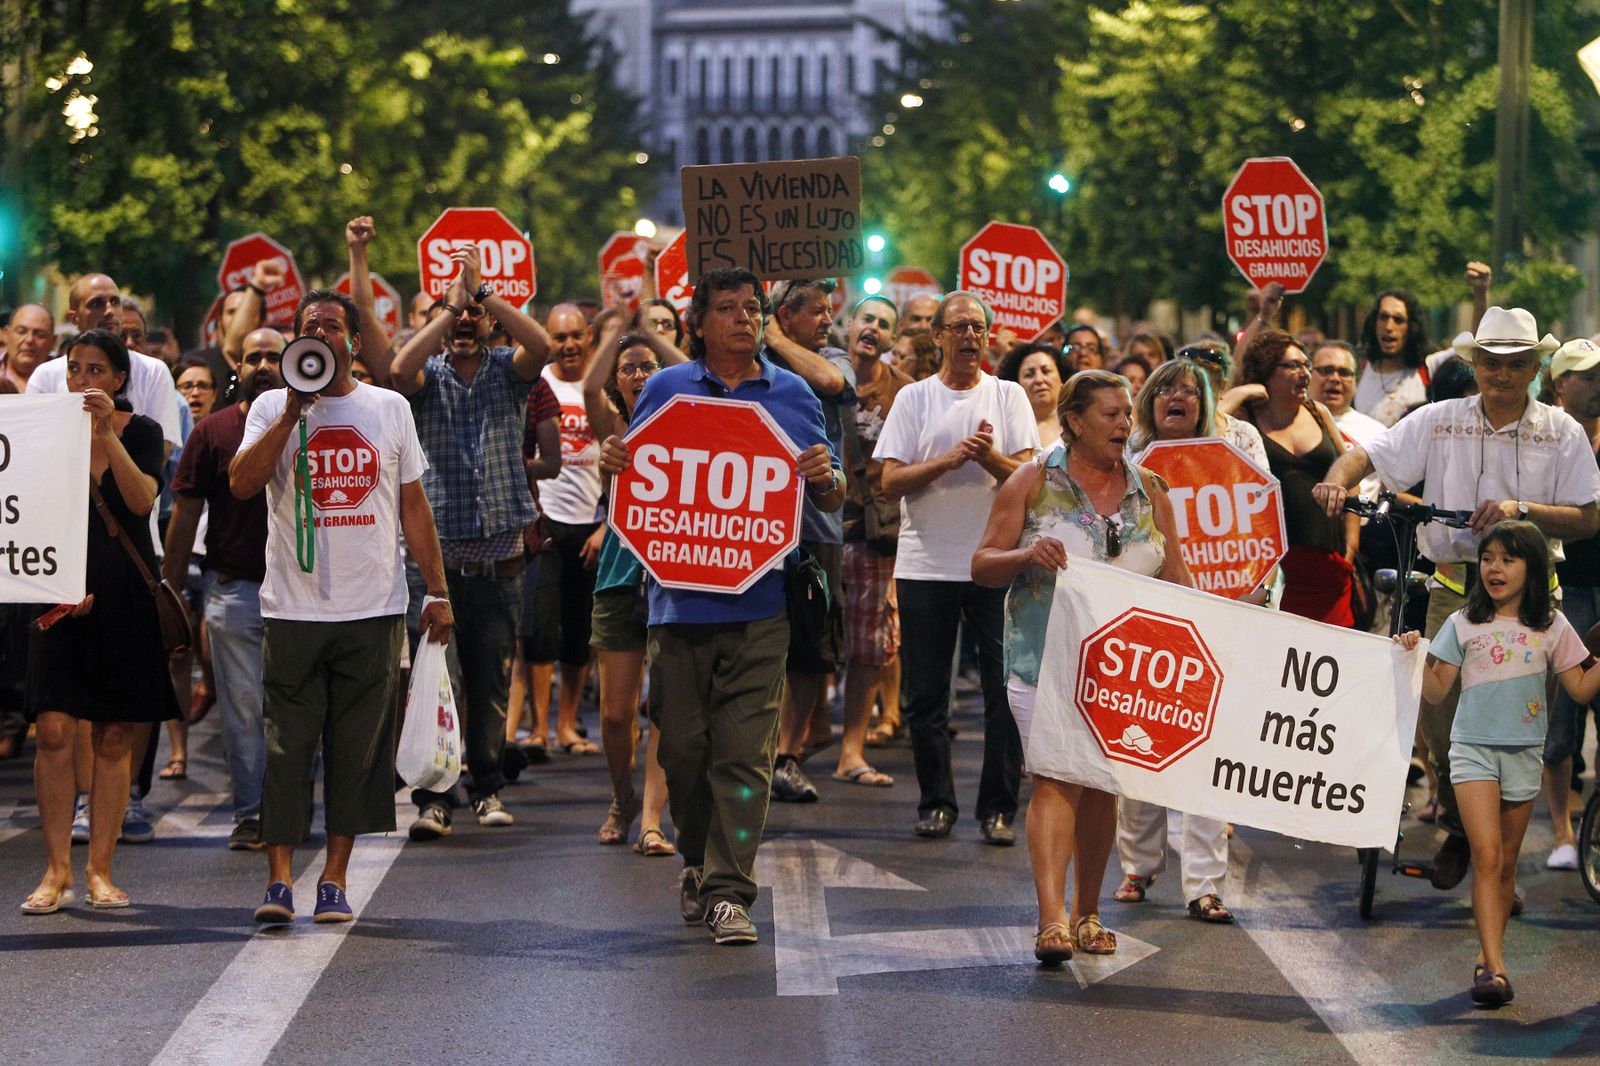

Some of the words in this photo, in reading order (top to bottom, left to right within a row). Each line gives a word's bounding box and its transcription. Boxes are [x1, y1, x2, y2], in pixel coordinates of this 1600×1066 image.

[698, 175, 728, 200] LA
[697, 204, 731, 237] NO
[740, 204, 767, 234] ES
[1231, 194, 1318, 237] STOP
[1234, 239, 1321, 257] DESAHUCIOS
[968, 248, 1060, 295] STOP
[1249, 262, 1308, 278] GRANADA
[307, 447, 373, 476] STOP
[630, 443, 791, 512] STOP
[311, 475, 372, 489] ESAHUCIOS
[324, 514, 376, 528] GRANADA
[626, 505, 786, 545] DESAHUCIOS
[1168, 482, 1269, 539] TOP
[647, 540, 753, 571] GRANADA
[1180, 536, 1276, 566] AHUCIOS
[1098, 637, 1205, 694] STOP
[1281, 647, 1340, 698] NO
[1083, 677, 1206, 732] Desahucios
[1259, 708, 1337, 756] más
[1212, 757, 1367, 814] muertes
